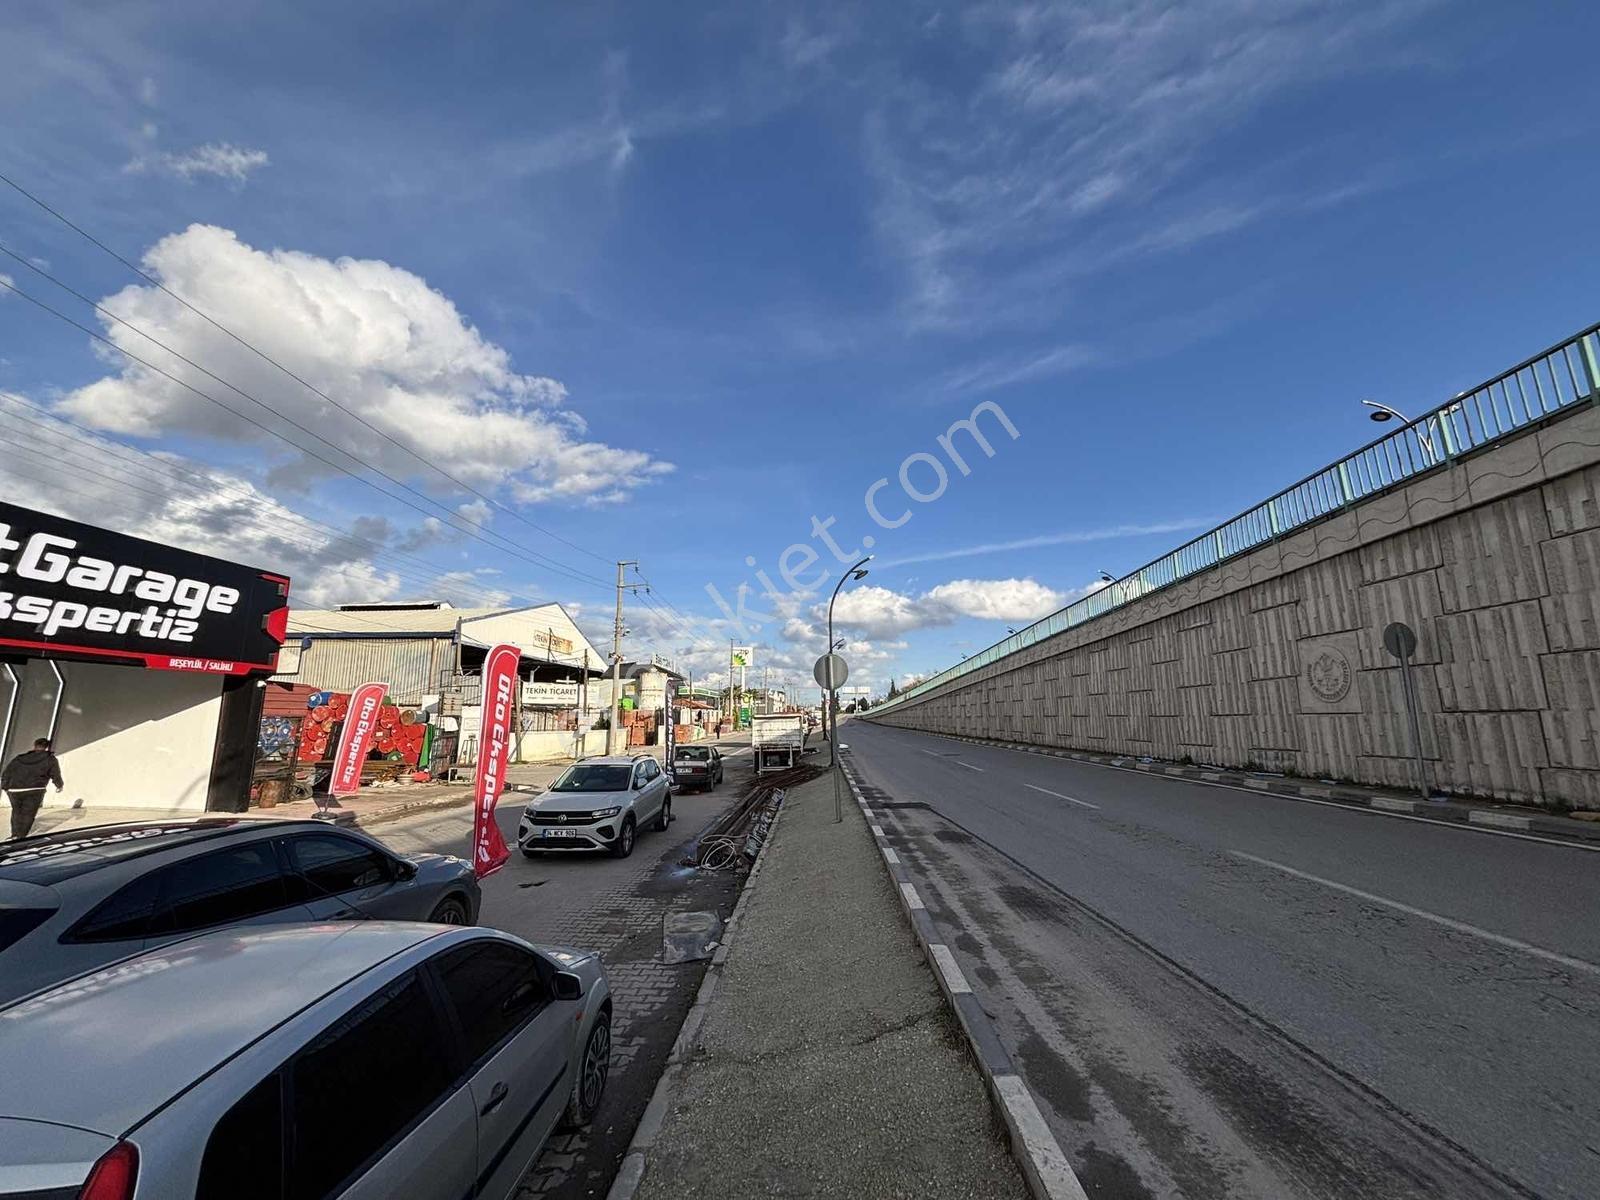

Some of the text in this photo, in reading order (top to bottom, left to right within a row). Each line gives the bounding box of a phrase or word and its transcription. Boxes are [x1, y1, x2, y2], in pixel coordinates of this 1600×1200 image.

[525, 685, 576, 695] TEKİN TİCARET
[342, 720, 369, 784] Ekspertiz
